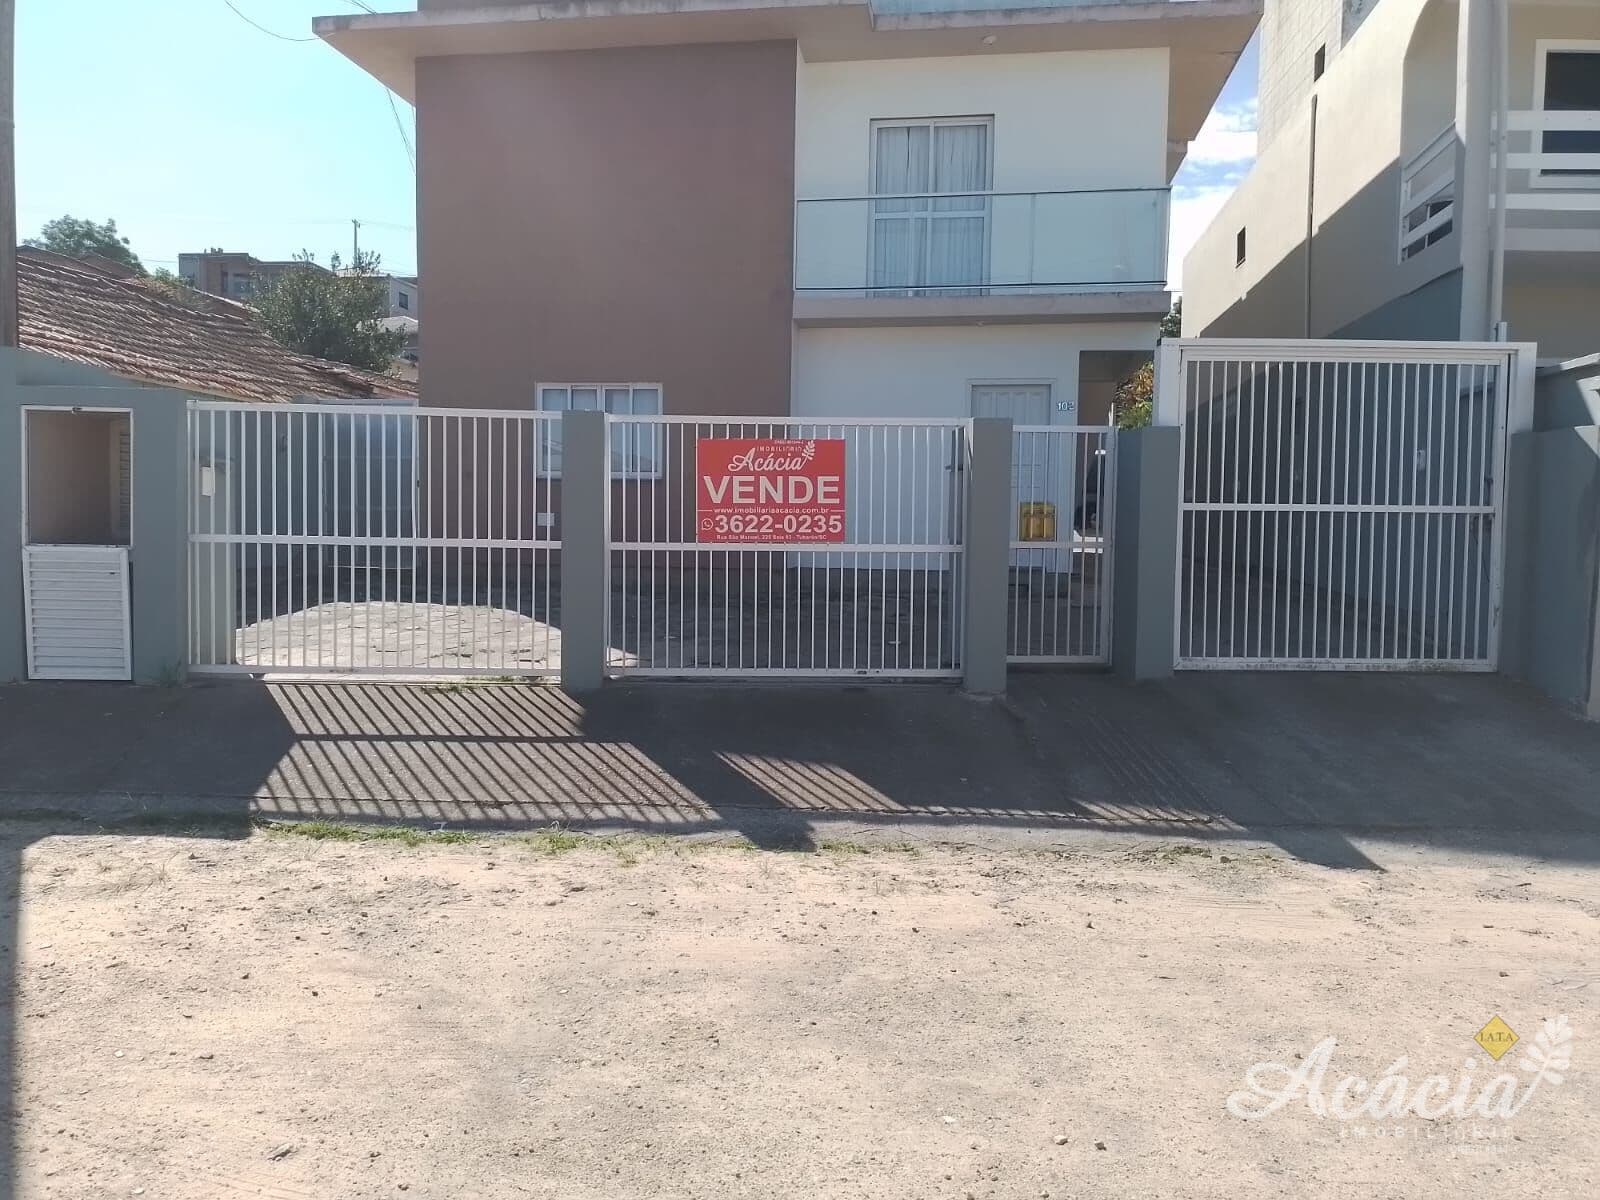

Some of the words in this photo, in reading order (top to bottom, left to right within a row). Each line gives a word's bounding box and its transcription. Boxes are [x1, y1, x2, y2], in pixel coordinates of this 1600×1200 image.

[727, 447, 804, 472] Acácia
[703, 475, 840, 504] VENDE
[715, 514, 842, 533] 3622-0235
